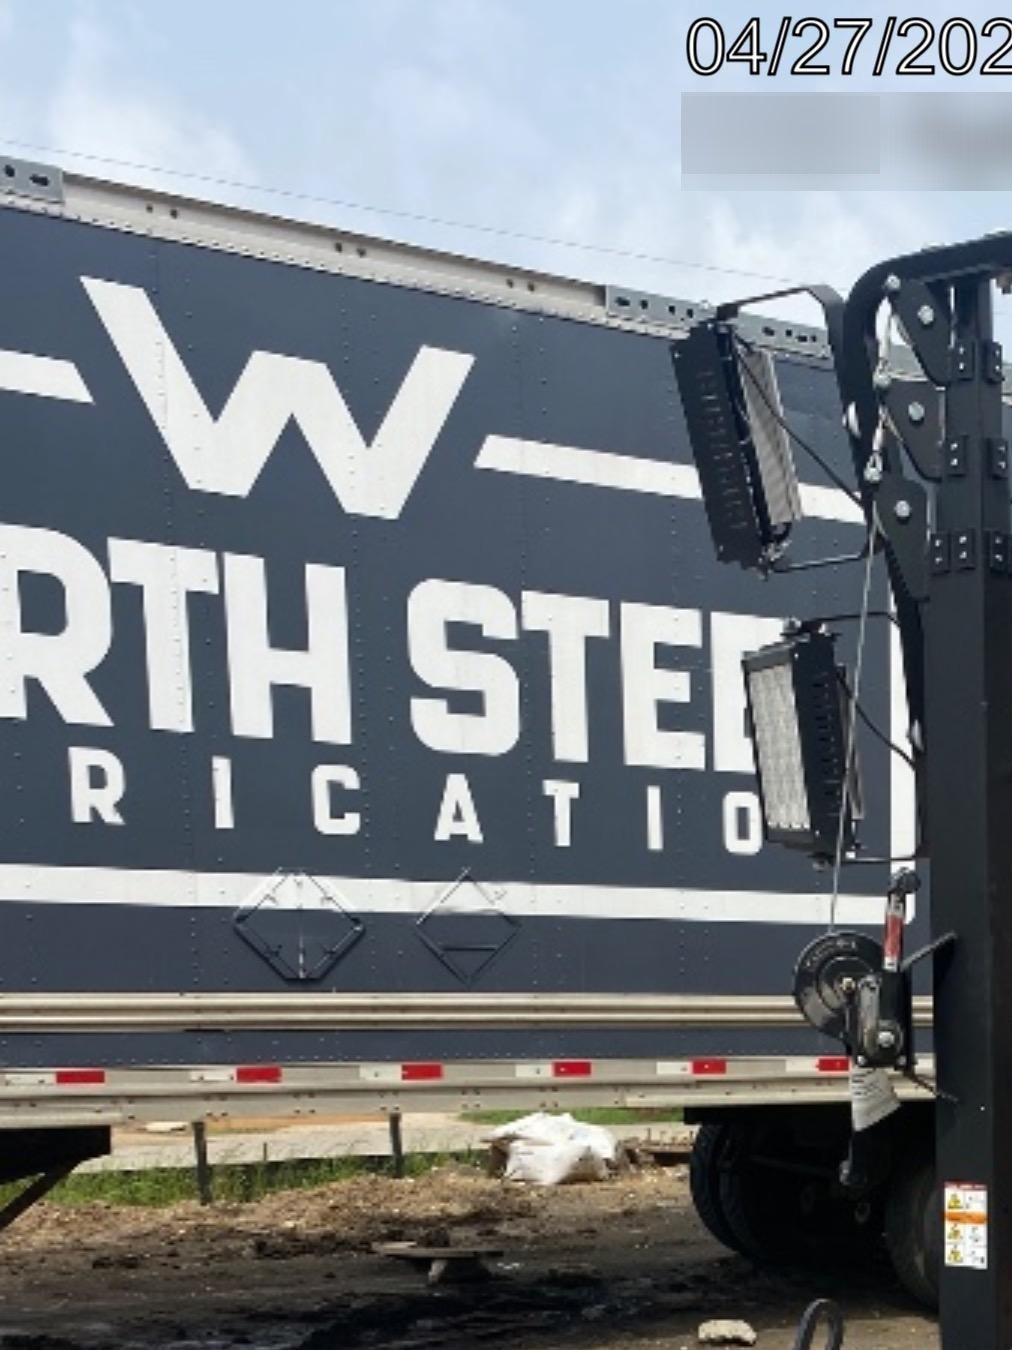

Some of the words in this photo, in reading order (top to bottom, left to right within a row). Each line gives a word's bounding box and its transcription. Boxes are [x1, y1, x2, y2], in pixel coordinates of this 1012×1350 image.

[79, 275, 476, 520] W
[407, 578, 787, 774] STEE
[68, 746, 764, 856] RICATIO
